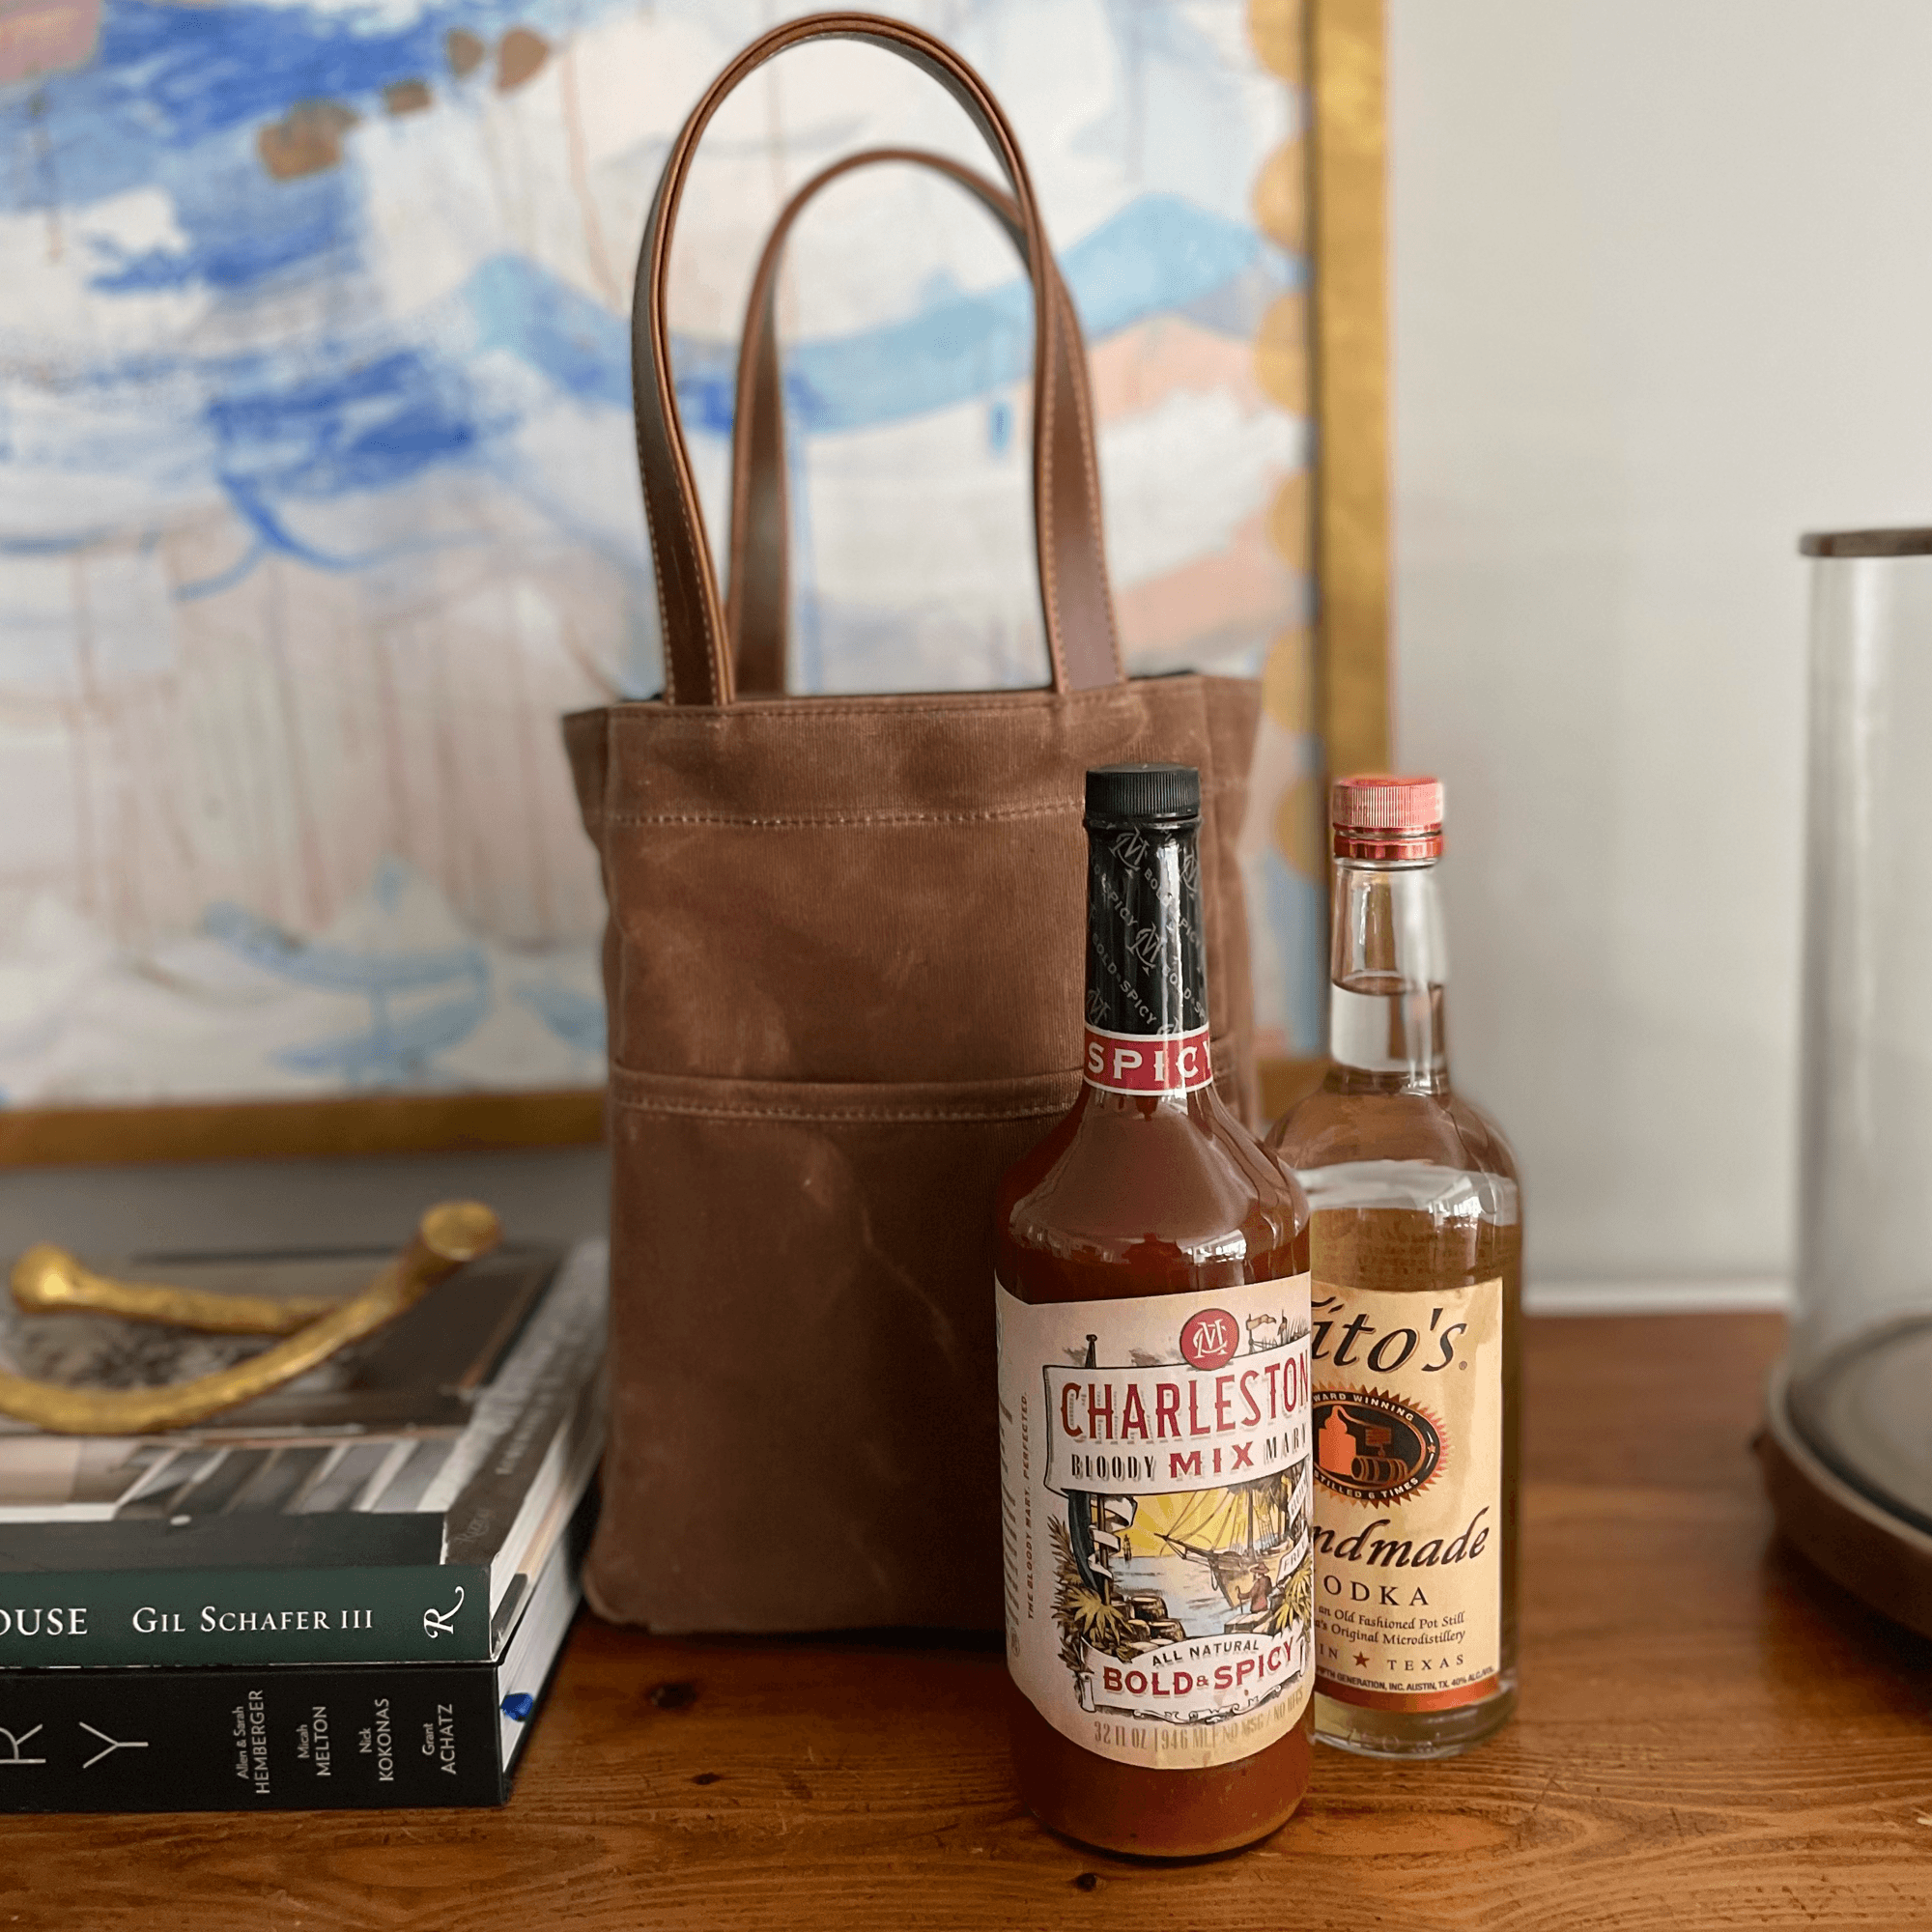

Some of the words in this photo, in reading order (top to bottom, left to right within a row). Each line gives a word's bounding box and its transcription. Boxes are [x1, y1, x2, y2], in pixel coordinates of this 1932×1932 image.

[1162, 963, 1192, 1000] BOD
[1120, 980, 1157, 1025] SPICY
[1312, 1296, 1467, 1373] ito's
[1061, 1349, 1309, 1441] CHARLESTON
[1313, 1392, 1347, 1403] WARD
[1352, 1394, 1414, 1421] WINNING
[1071, 1453, 1156, 1480] BLOODY
[1169, 1441, 1254, 1479] MIX
[1314, 1470, 1362, 1497] STILLED
[1380, 1477, 1419, 1497] TIMES
[1313, 1506, 1490, 1567] ndmade
[1322, 1575, 1429, 1606] ODKA
[340, 1609, 374, 1630] III
[1319, 1605, 1331, 1616] an
[1334, 1609, 1355, 1623] Old
[1358, 1614, 1416, 1630] Fashioned
[1419, 1618, 1438, 1630] Pot
[1441, 1610, 1465, 1628] Still
[1331, 1623, 1378, 1642] Original
[1382, 1630, 1465, 1645] Microdistillery
[1103, 1665, 1194, 1696] BOLD
[1213, 1636, 1294, 1690] SPICY
[1152, 1650, 1183, 1667] ALL
[1189, 1639, 1260, 1658] NATURAL
[1386, 1653, 1463, 1671] TEXAS
[1337, 1672, 1387, 1690] GENERATION,
[1389, 1682, 1405, 1690] INC.
[1406, 1682, 1437, 1690] AUSTIN,
[1451, 1676, 1467, 1687] 40%
[232, 1706, 245, 1737] Sarah
[1094, 1720, 1111, 1745] 32
[1131, 1727, 1147, 1749] OZ
[1161, 1728, 1188, 1750] 946
[1274, 1701, 1286, 1720] NO
[248, 1690, 270, 1794] HEMBERGER
[296, 1724, 310, 1759] Micah
[312, 1706, 331, 1776] MELTON
[358, 1728, 372, 1753] Nick
[375, 1698, 394, 1781] KOKONAS
[422, 1723, 435, 1756] Grant
[438, 1703, 457, 1776] ACHATZ
[237, 1750, 249, 1779] Allen
